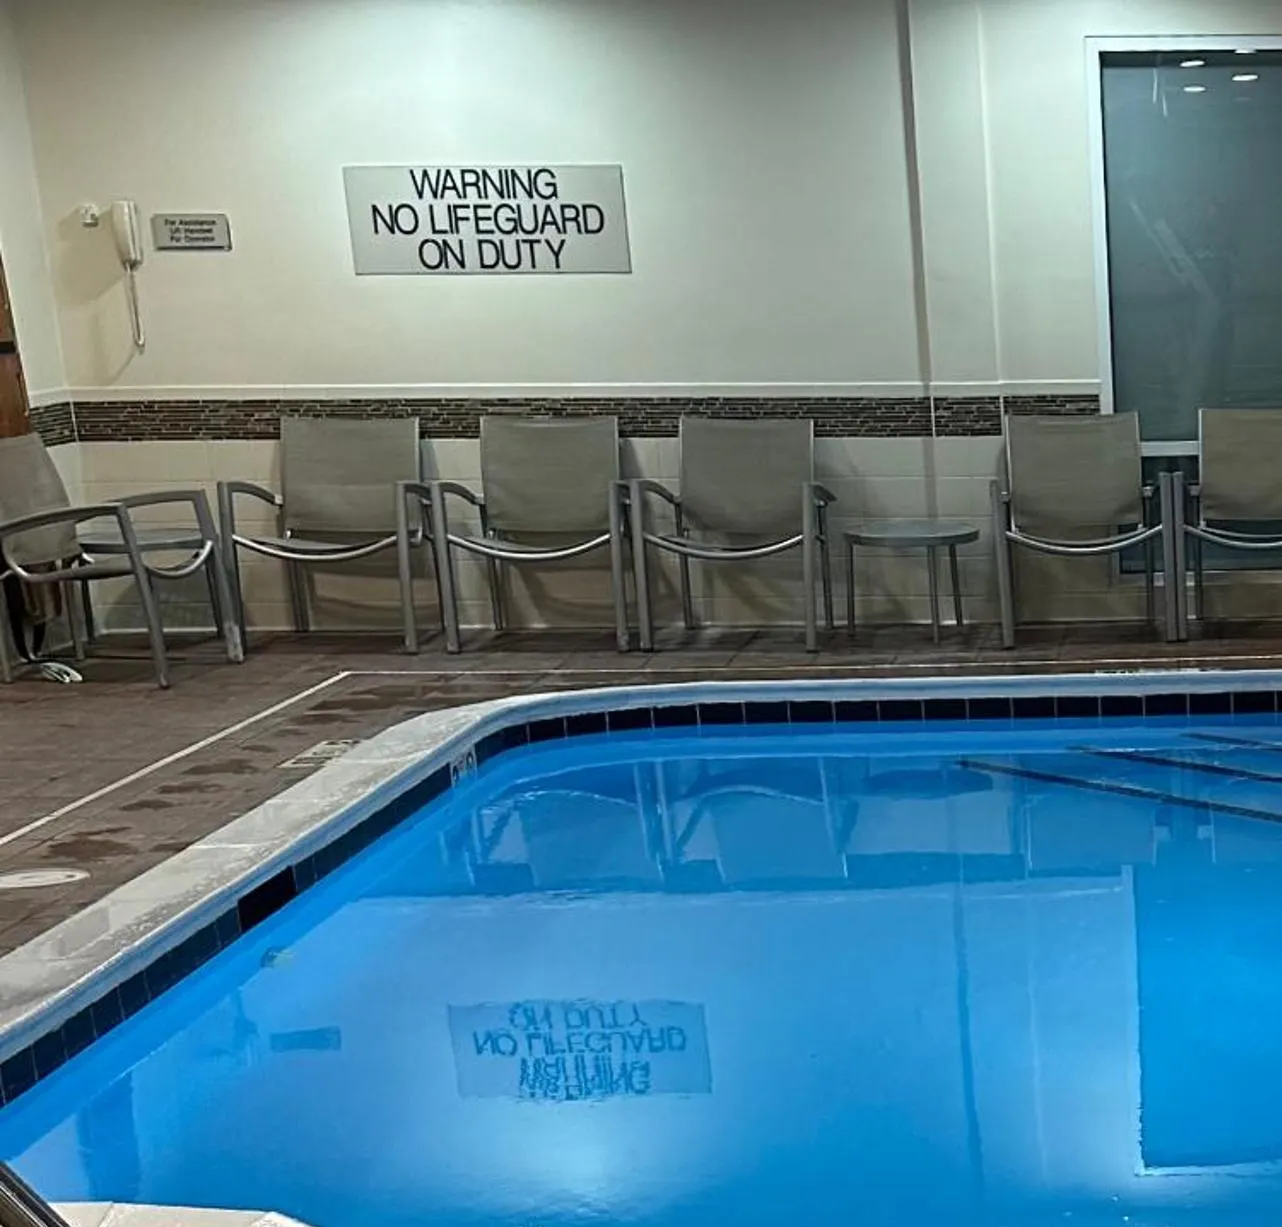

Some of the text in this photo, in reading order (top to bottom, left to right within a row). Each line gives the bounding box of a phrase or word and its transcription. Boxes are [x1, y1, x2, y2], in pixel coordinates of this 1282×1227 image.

[409, 168, 558, 200] WARNING
[371, 203, 605, 236] NO LIFEGUARD
[418, 238, 566, 270] ON DUTY
